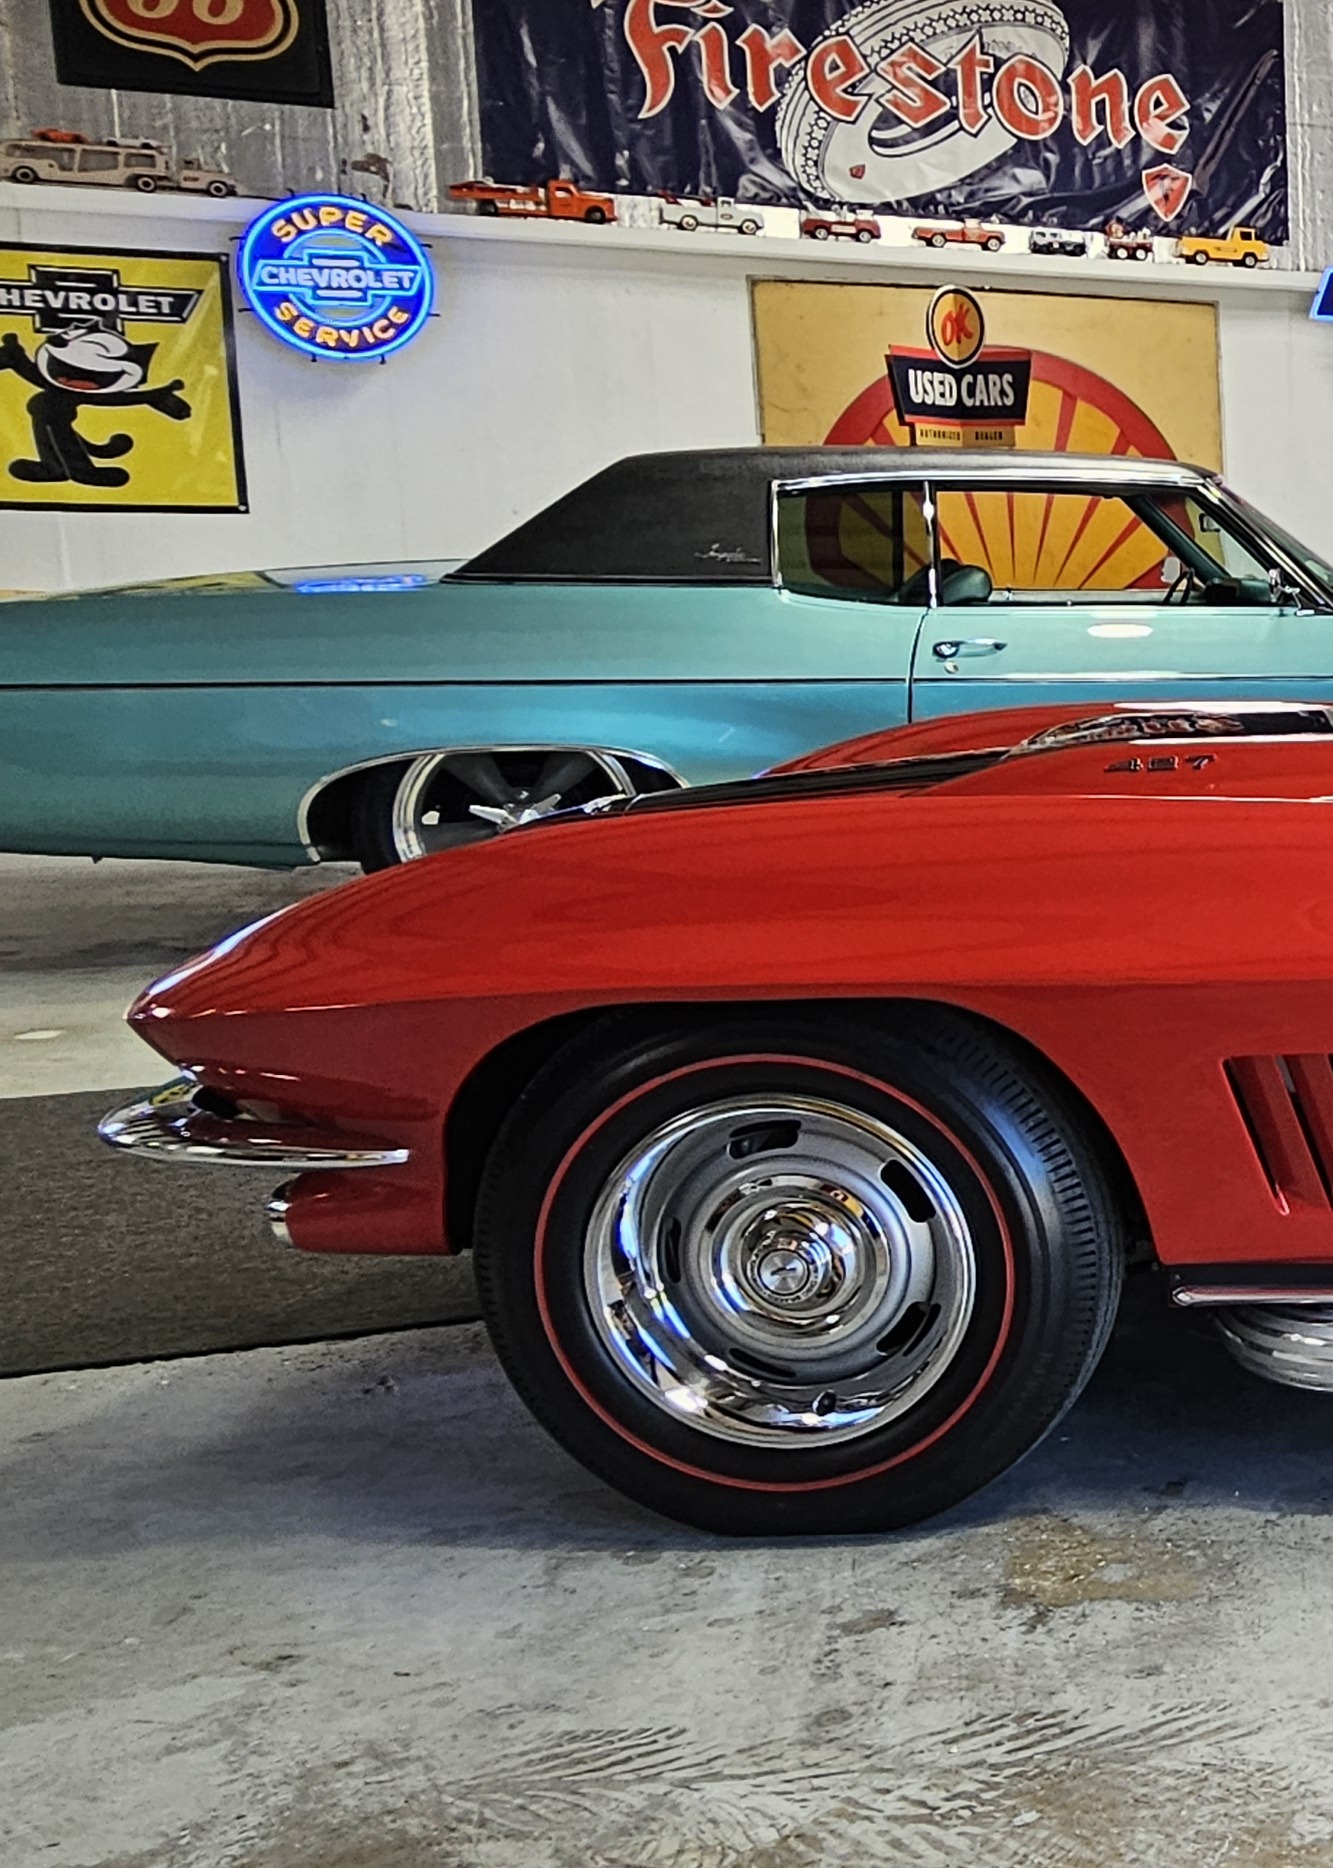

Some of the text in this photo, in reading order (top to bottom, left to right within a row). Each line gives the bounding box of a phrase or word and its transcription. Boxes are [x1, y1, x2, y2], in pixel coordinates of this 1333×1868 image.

[624, 0, 1191, 154] Firestone
[272, 207, 393, 246] SUPER
[261, 265, 415, 289] CHEVROLET
[274, 302, 411, 347] SERVICE
[941, 302, 974, 347] OK
[908, 369, 1015, 407] USED CARS
